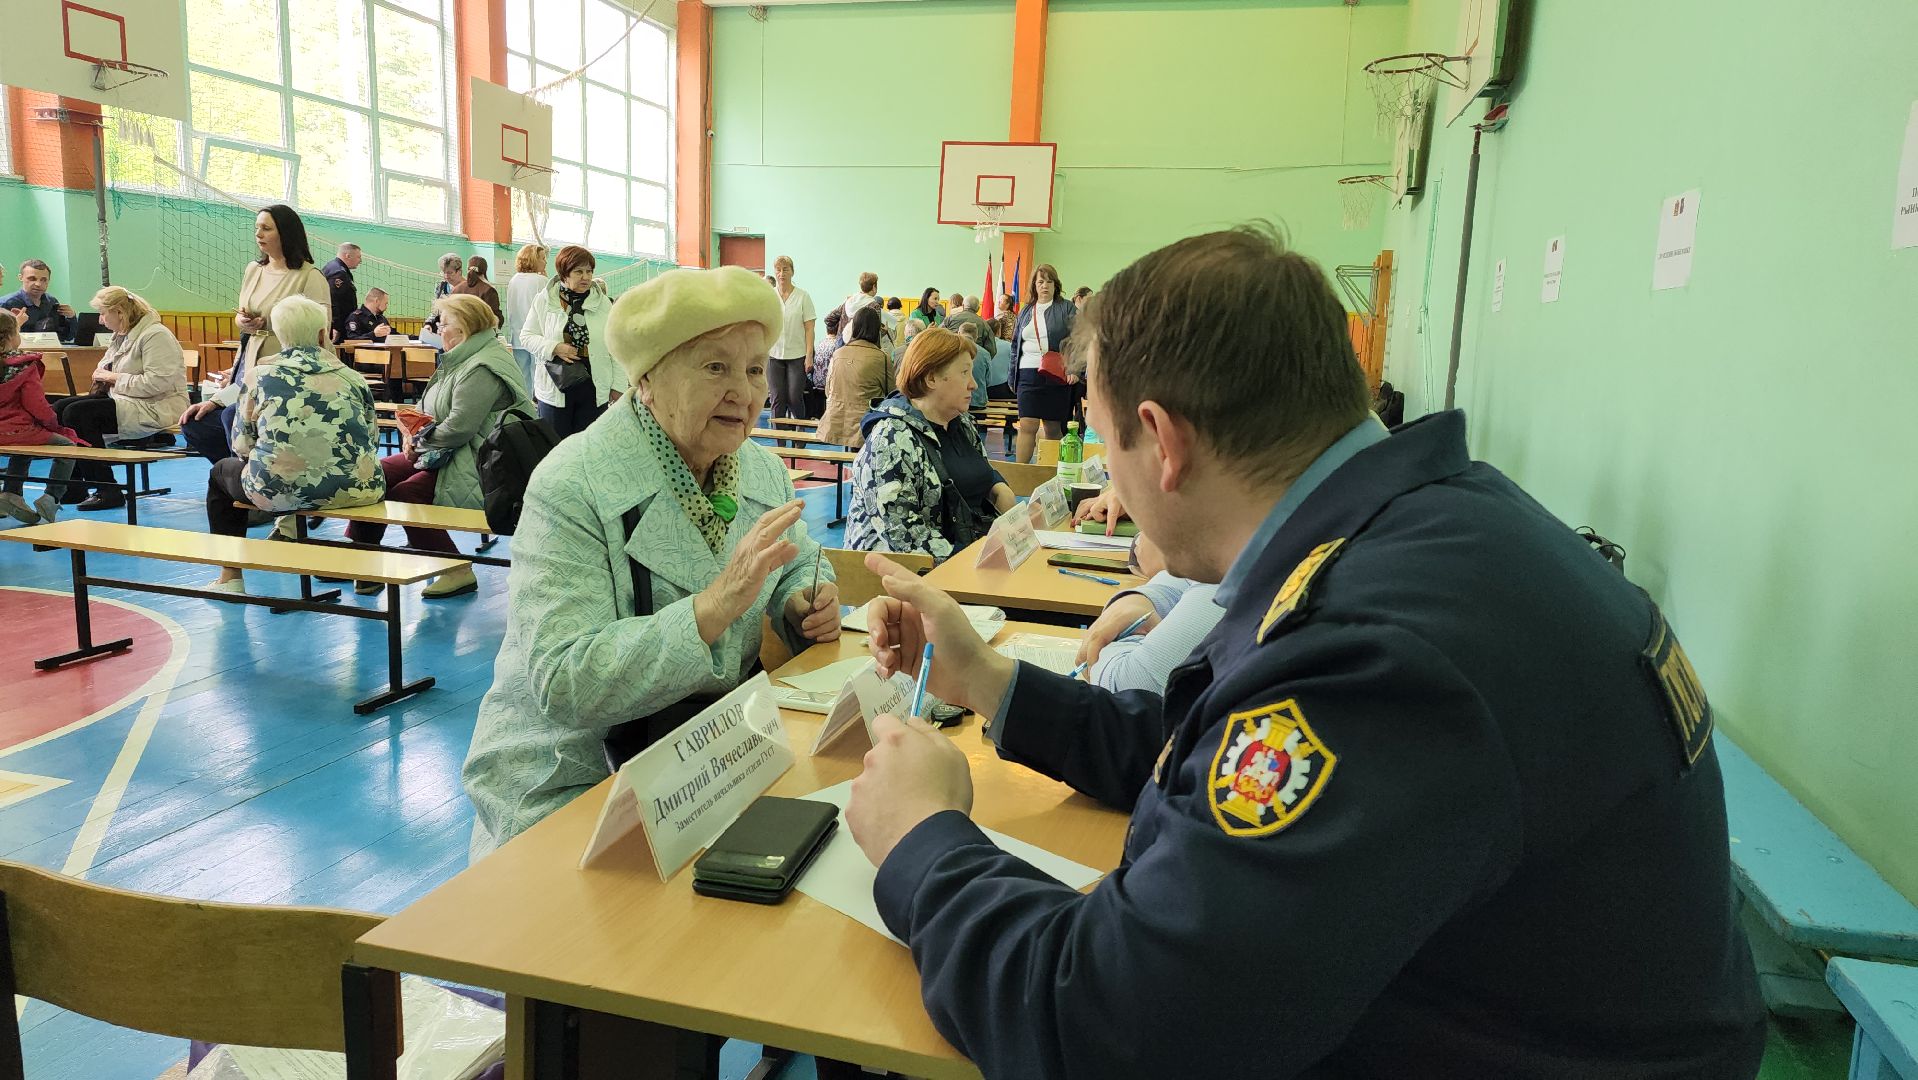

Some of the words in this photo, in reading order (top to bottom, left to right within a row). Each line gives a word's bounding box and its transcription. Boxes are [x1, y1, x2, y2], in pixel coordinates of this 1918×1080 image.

[673, 703, 745, 763] ГАВРИЛОВ
[652, 765, 711, 829] Дмитрий
[709, 718, 779, 779] Вячеславович
[674, 795, 714, 833] Заместитель
[714, 774, 746, 802] начальника
